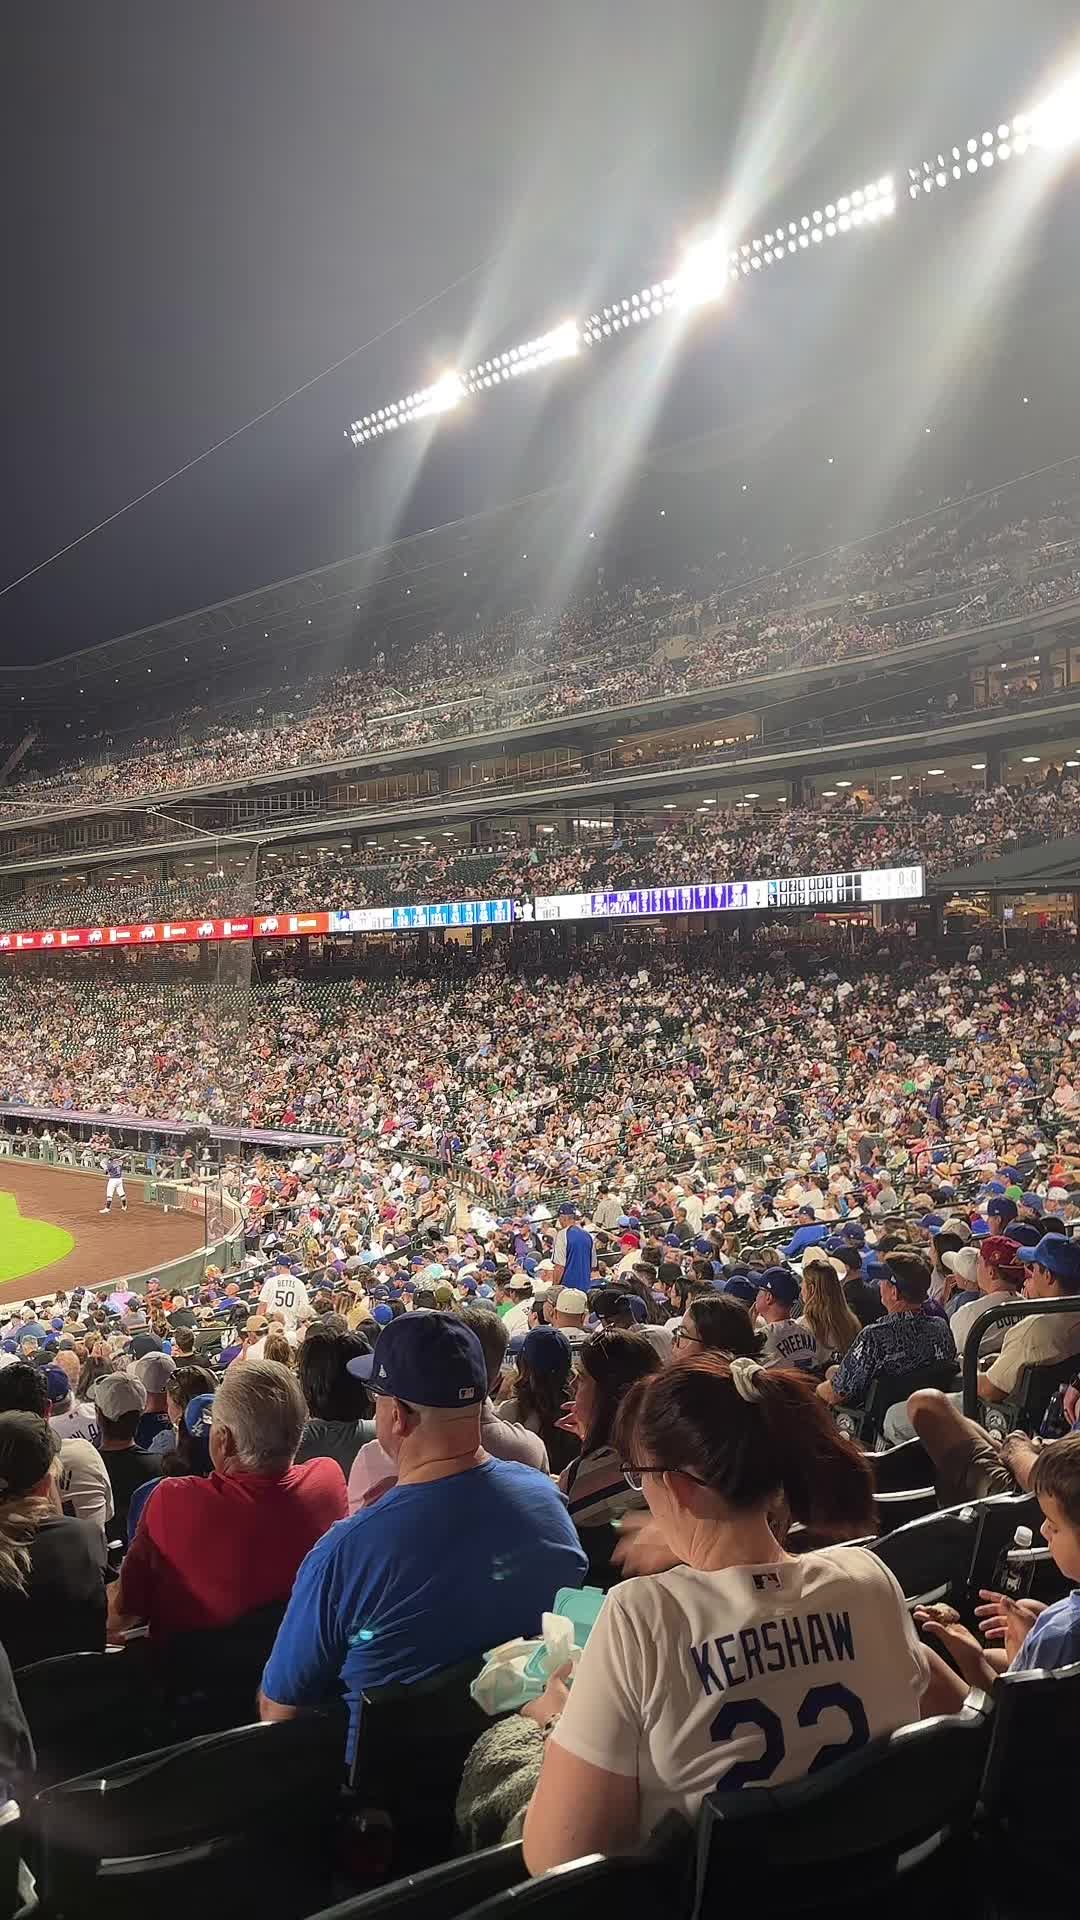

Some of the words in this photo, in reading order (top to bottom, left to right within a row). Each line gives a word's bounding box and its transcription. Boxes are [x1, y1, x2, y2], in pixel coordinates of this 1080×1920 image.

[275, 1290, 295, 1308] 50
[277, 1280, 296, 1289] BETTS
[690, 1611, 855, 1696] KERSHAW
[709, 1682, 871, 1792] 22
